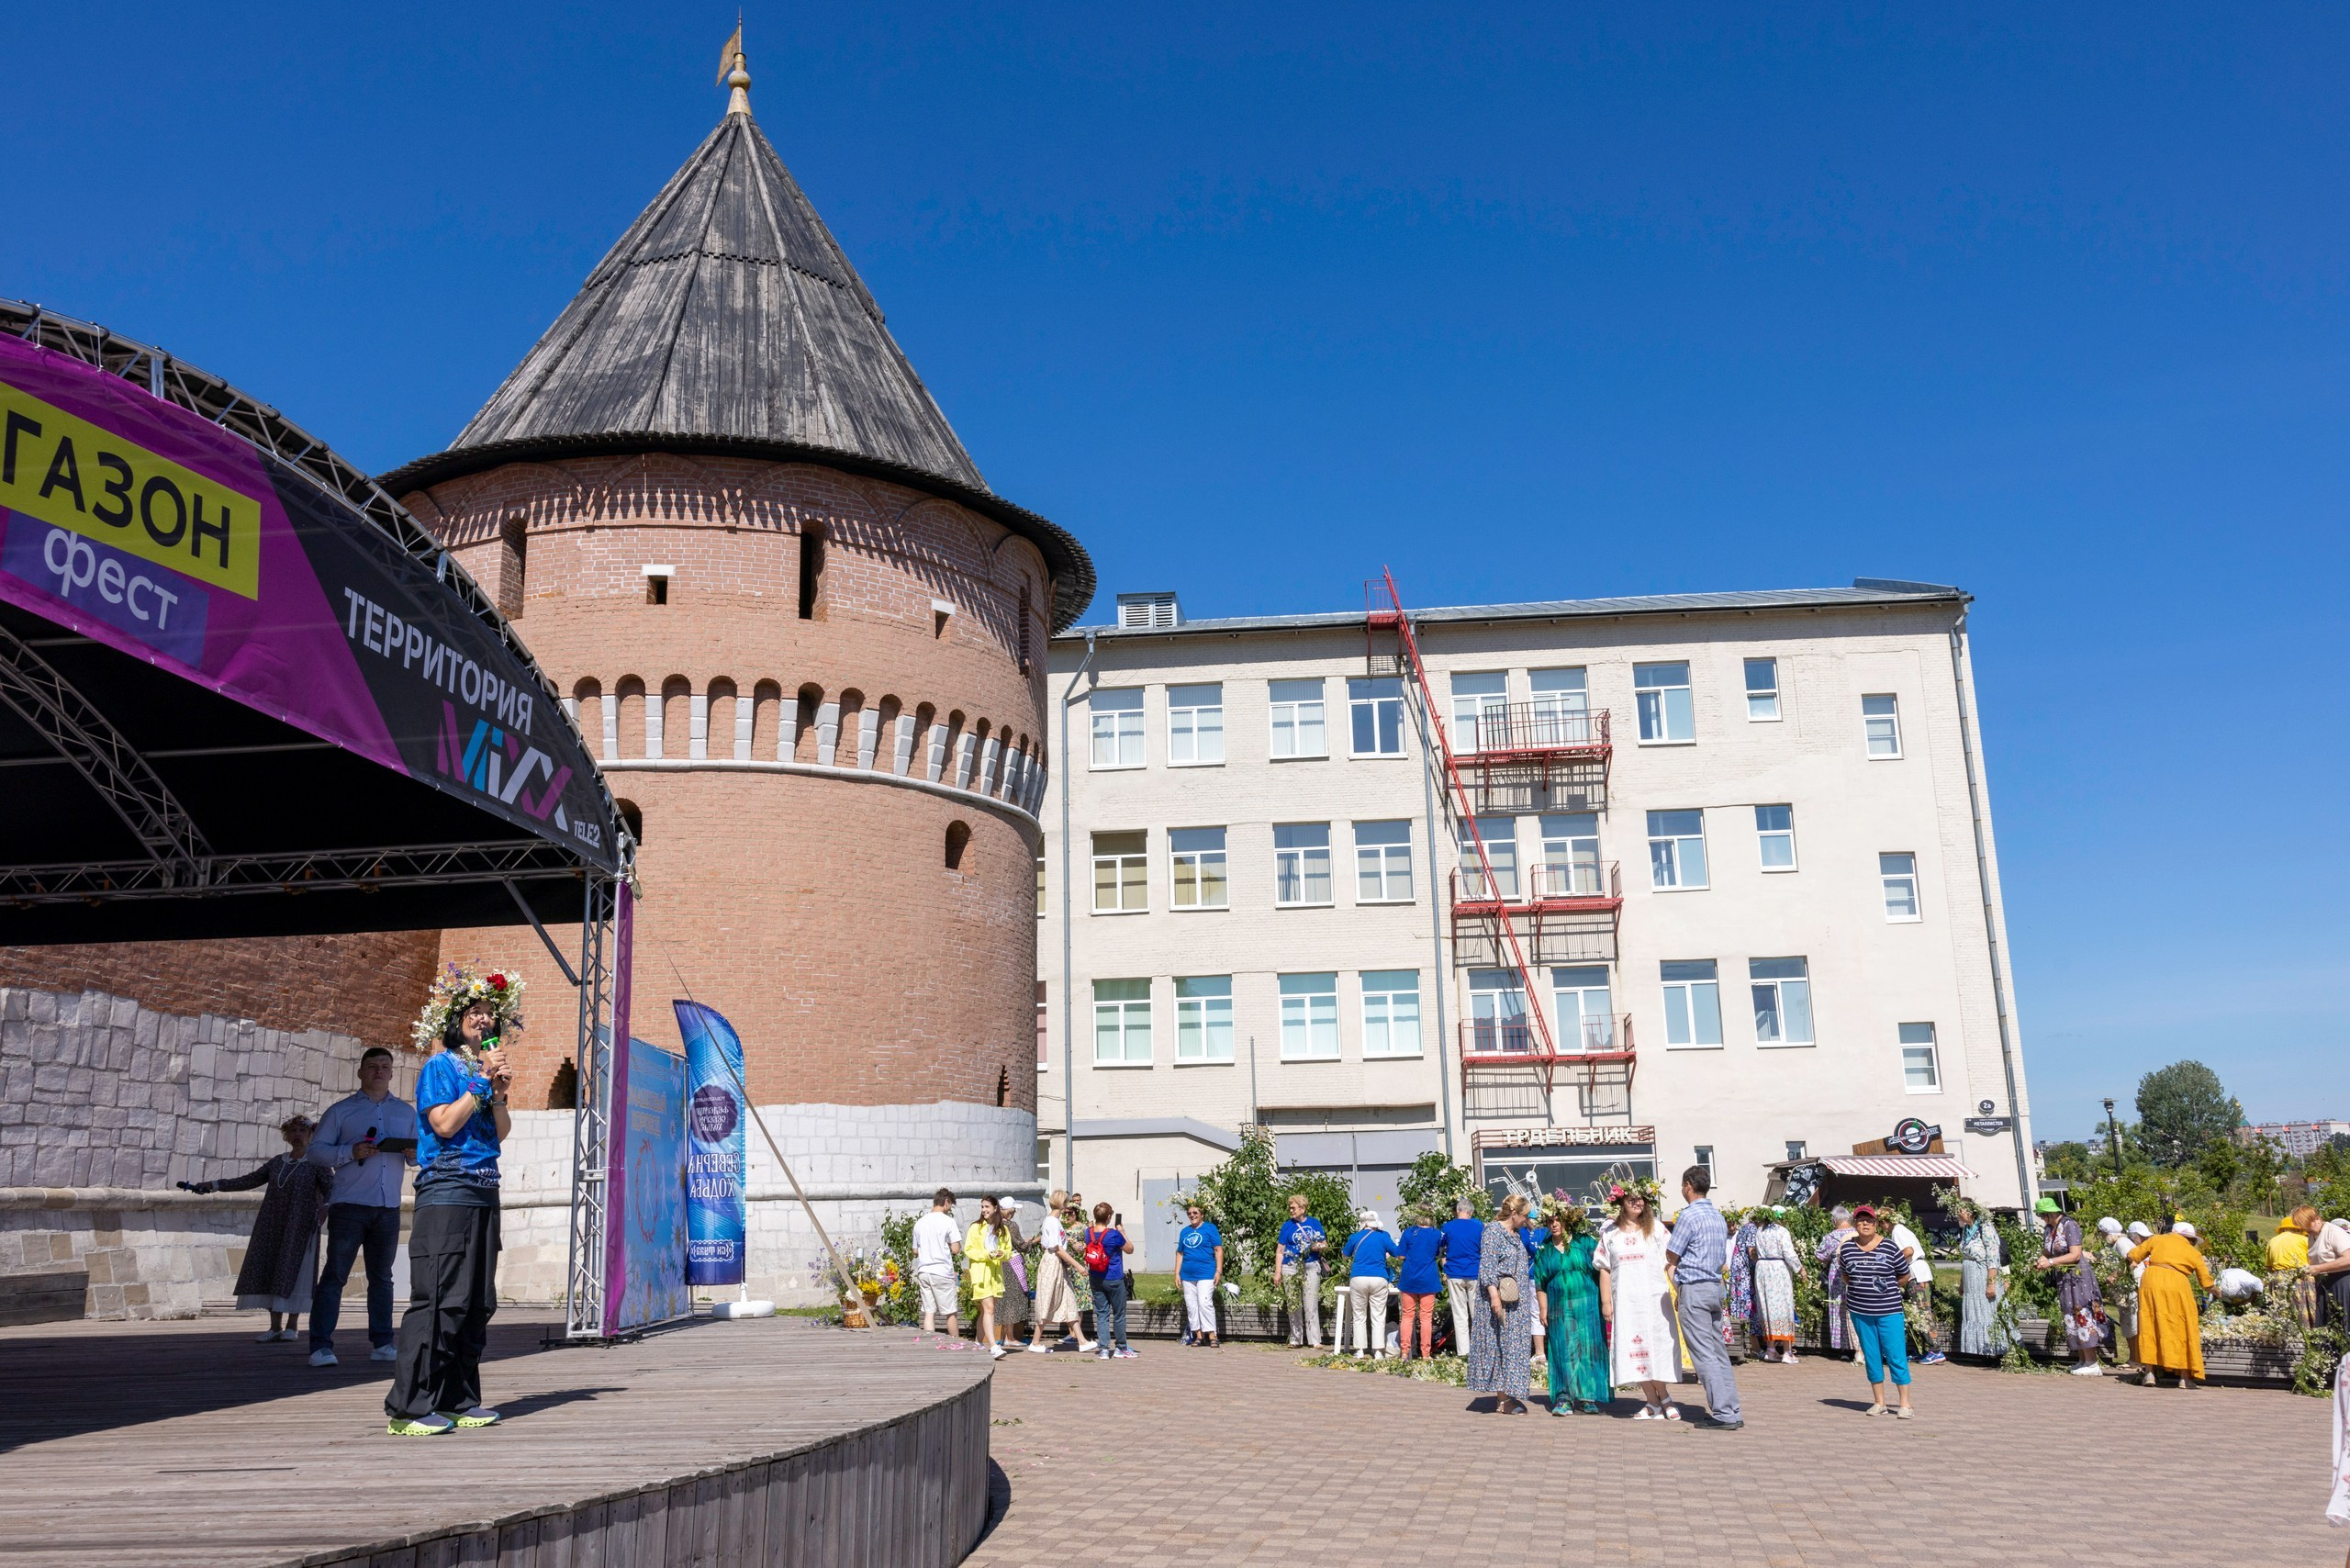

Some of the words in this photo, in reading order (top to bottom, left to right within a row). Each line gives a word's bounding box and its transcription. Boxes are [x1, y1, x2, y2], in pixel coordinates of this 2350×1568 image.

[3, 409, 230, 569] ГАЗОН
[44, 528, 178, 631] фест
[344, 586, 533, 736] ТЕРРИТОРИЯ
[574, 820, 600, 849] TELE2
[1502, 1126, 1631, 1147] ТРДЕЛЬНИК
